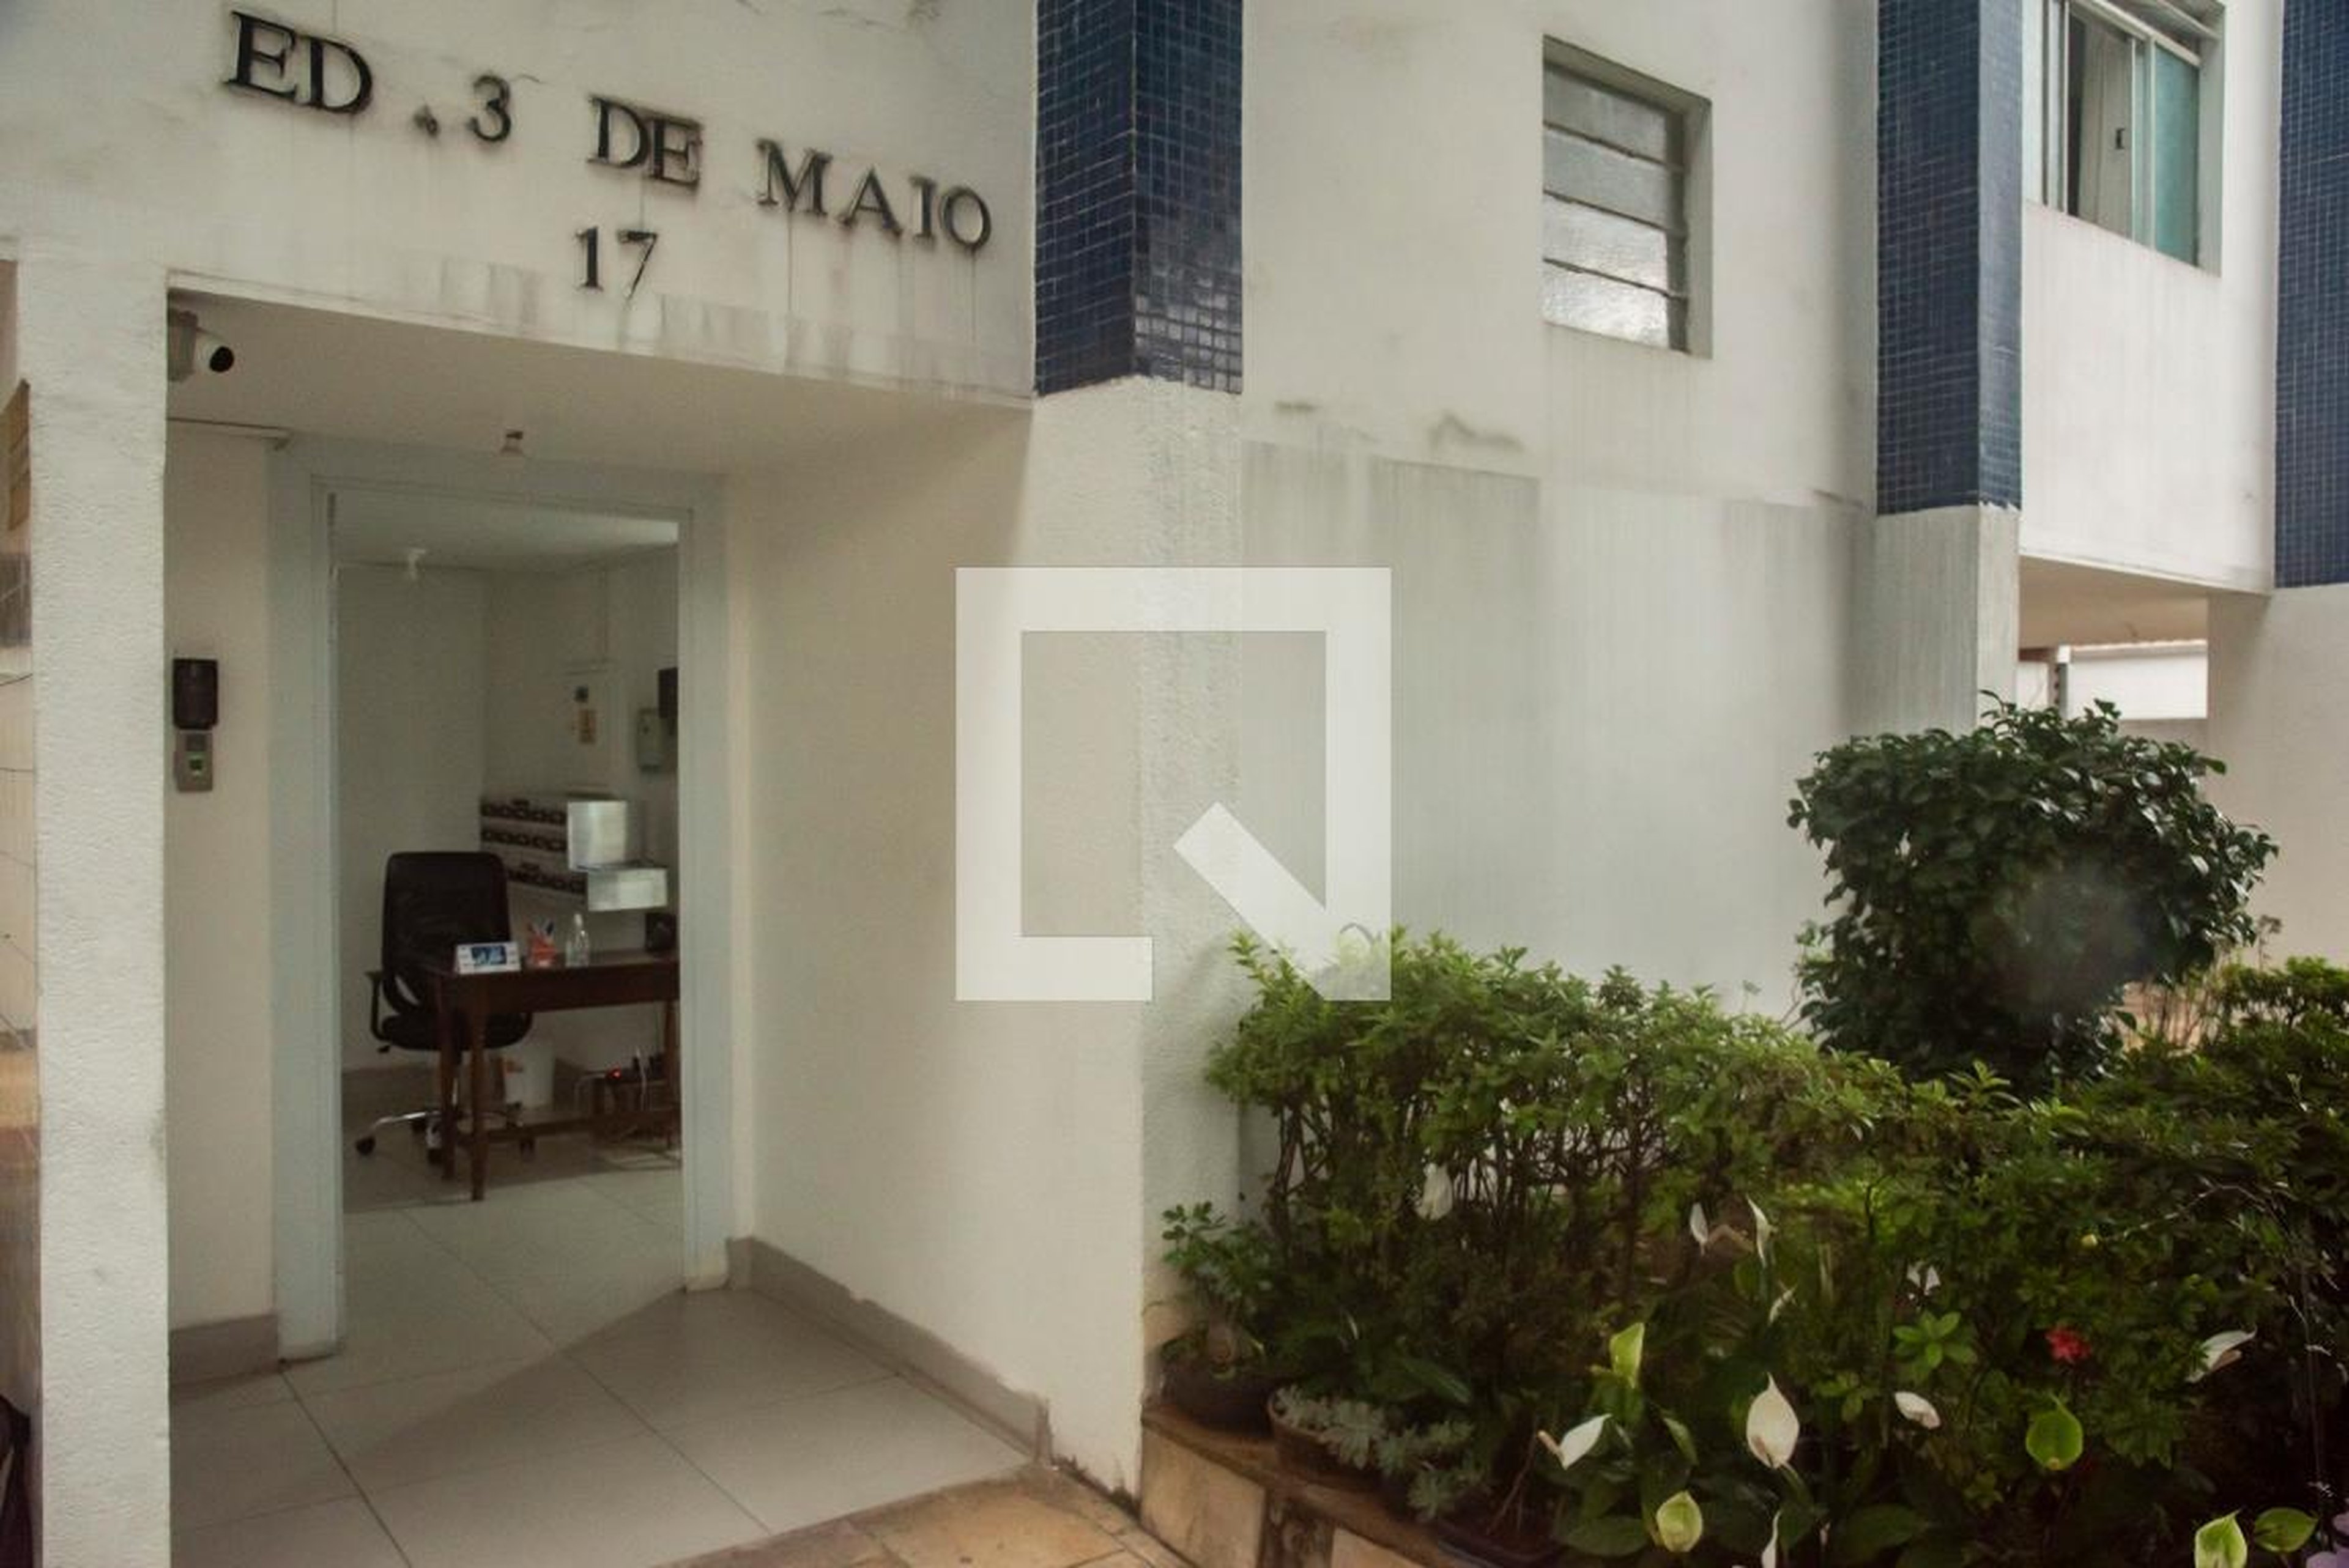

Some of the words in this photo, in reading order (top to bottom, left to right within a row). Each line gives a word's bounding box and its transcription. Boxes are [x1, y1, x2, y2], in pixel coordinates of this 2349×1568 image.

[587, 94, 702, 191] DE
[756, 138, 992, 248] MAIO
[576, 226, 658, 298] 17
